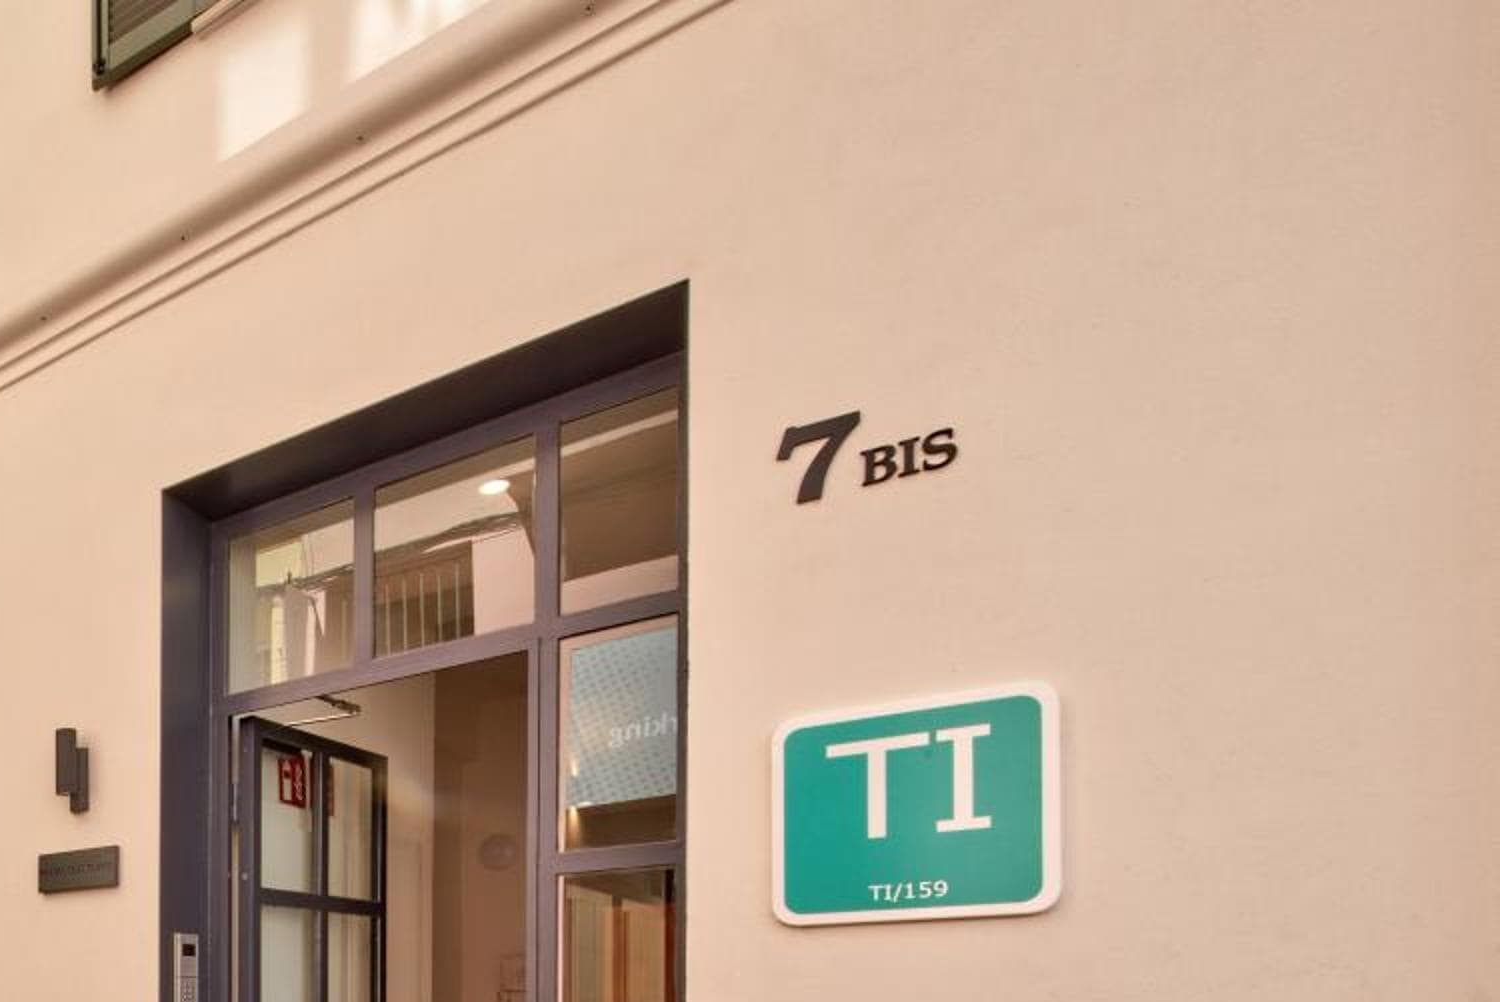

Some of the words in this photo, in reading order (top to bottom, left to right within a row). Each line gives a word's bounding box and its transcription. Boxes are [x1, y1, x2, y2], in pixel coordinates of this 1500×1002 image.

[776, 410, 861, 505] 7
[860, 428, 959, 488] BIS
[825, 722, 993, 840] TI
[868, 880, 949, 902] TI/159
